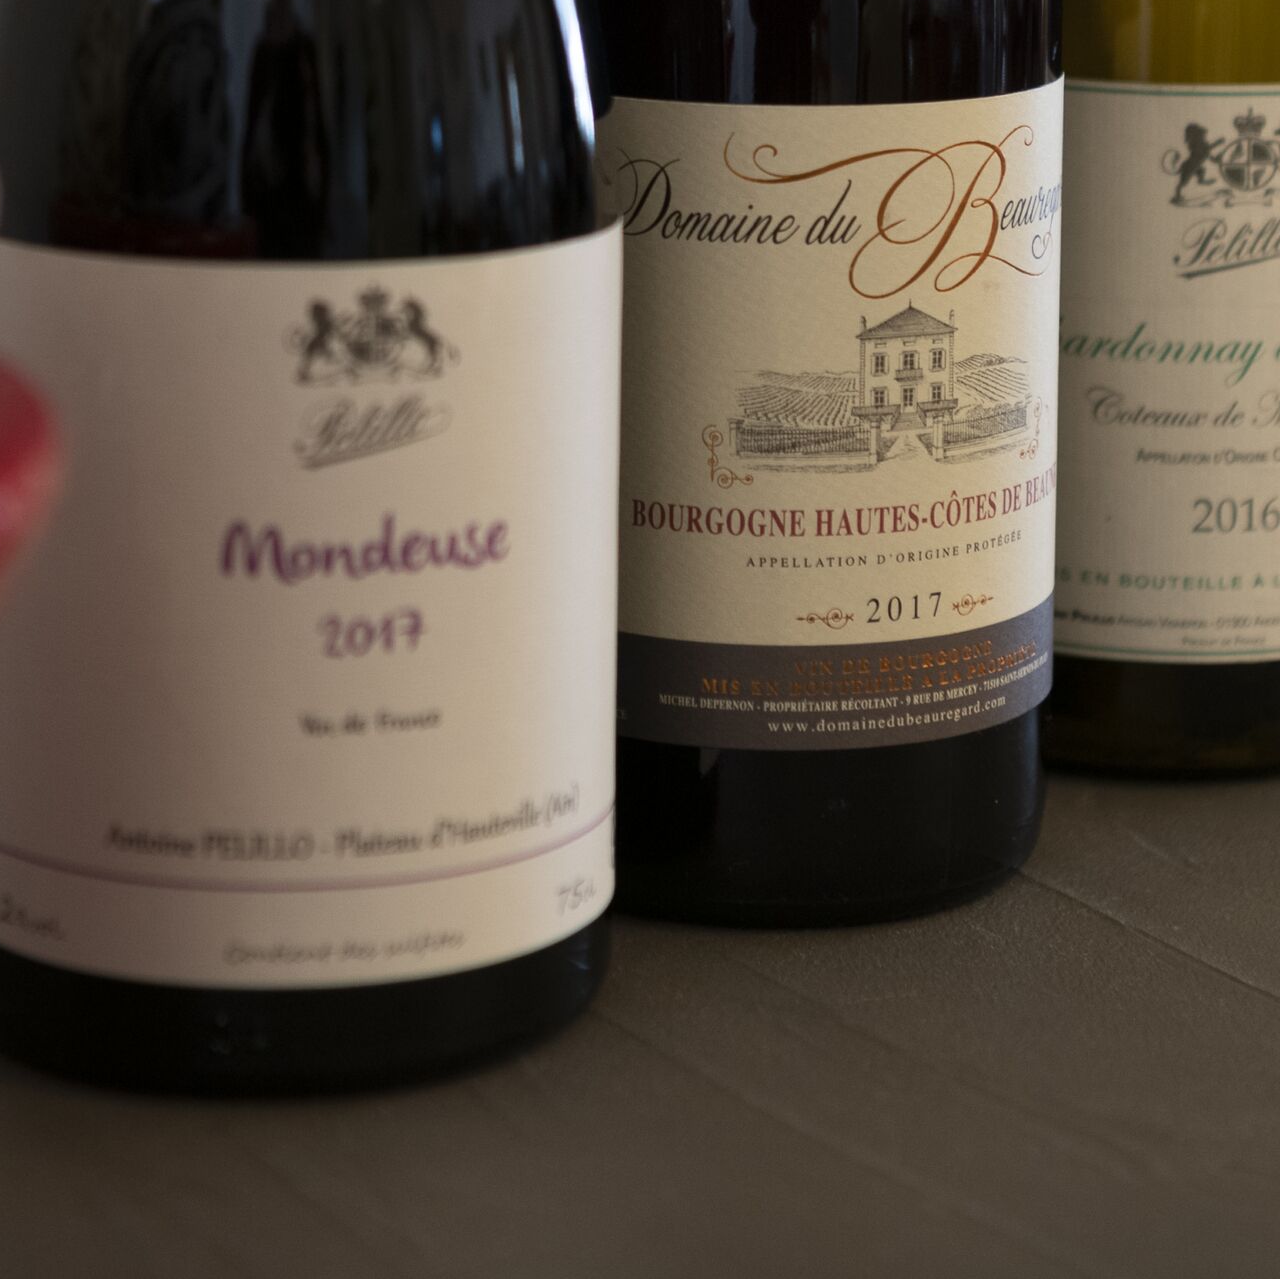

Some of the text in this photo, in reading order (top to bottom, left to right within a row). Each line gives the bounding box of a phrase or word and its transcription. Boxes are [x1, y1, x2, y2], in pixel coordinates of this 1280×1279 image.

[617, 148, 799, 245] Domaine
[804, 180, 861, 245] du
[1059, 321, 1264, 388] ardonnay
[1086, 385, 1205, 428] Coteaux
[1213, 400, 1245, 427] de
[632, 462, 1056, 538] BOURGOGNE HAUTES-CÔTES DE BEAUN
[220, 513, 511, 585] Mondeuse
[746, 556, 867, 569] APPELLATION
[877, 547, 959, 566] D'ORIGINE
[866, 592, 943, 623] 2017
[321, 609, 424, 658] 2017
[658, 694, 697, 709] MICHEL
[700, 697, 754, 712] DEPERNON
[763, 699, 838, 712] PROPRIÉTAIRE
[841, 696, 898, 711] RÉCOLTANT
[913, 693, 931, 704] RUE
[933, 690, 945, 702] DE
[702, 678, 741, 695] MIS
[767, 695, 1006, 733] www.domainedubeauregard.com
